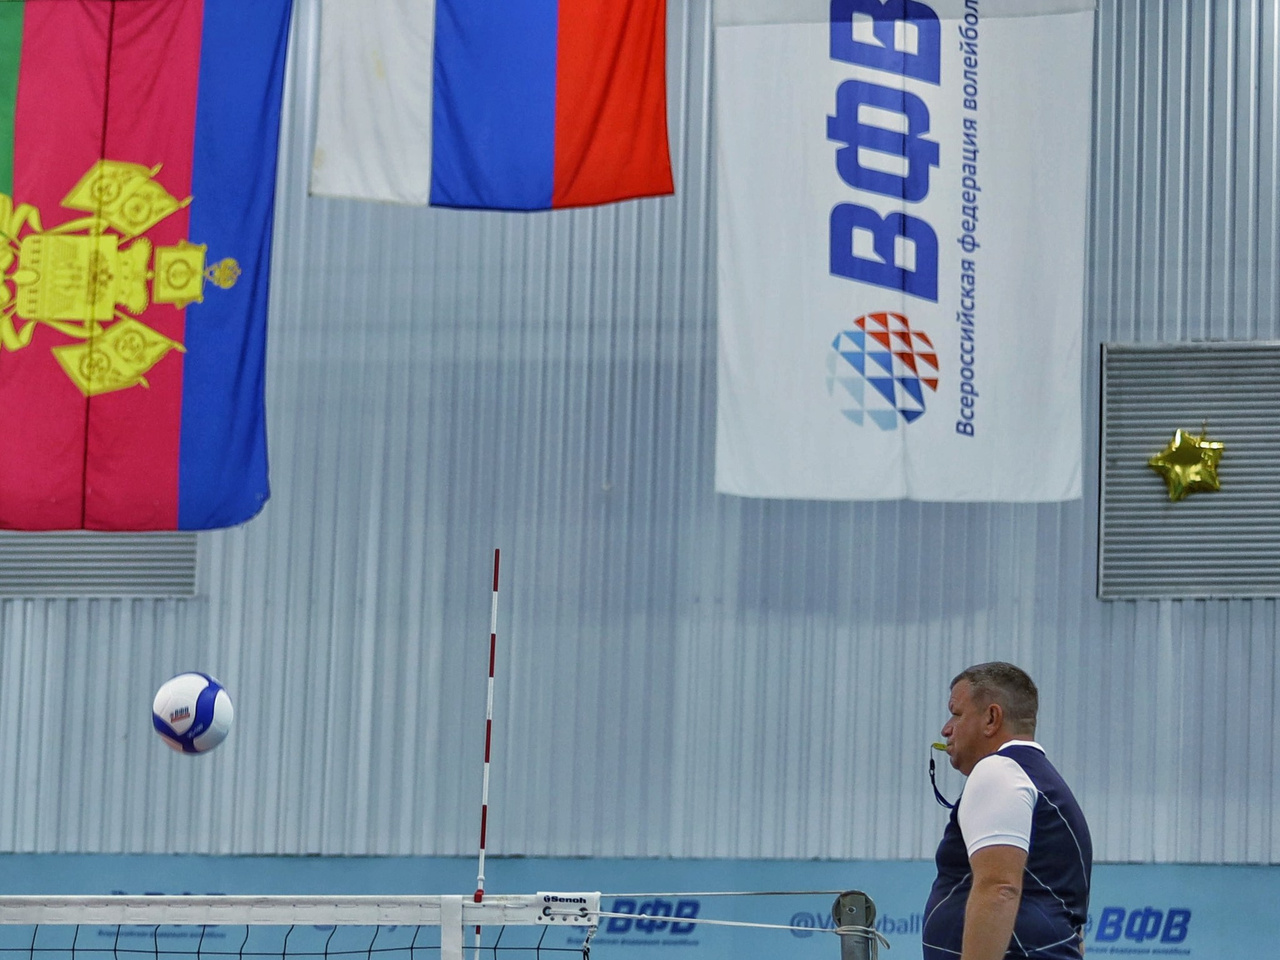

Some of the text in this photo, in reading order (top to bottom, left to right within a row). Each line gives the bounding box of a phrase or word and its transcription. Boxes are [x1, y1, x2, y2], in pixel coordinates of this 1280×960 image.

[826, 0, 941, 303] ВФВ
[956, 117, 981, 253] федерация
[956, 258, 980, 438] Всероссийская
[606, 898, 701, 935] ВФВ
[1095, 906, 1192, 944] ВФВ
